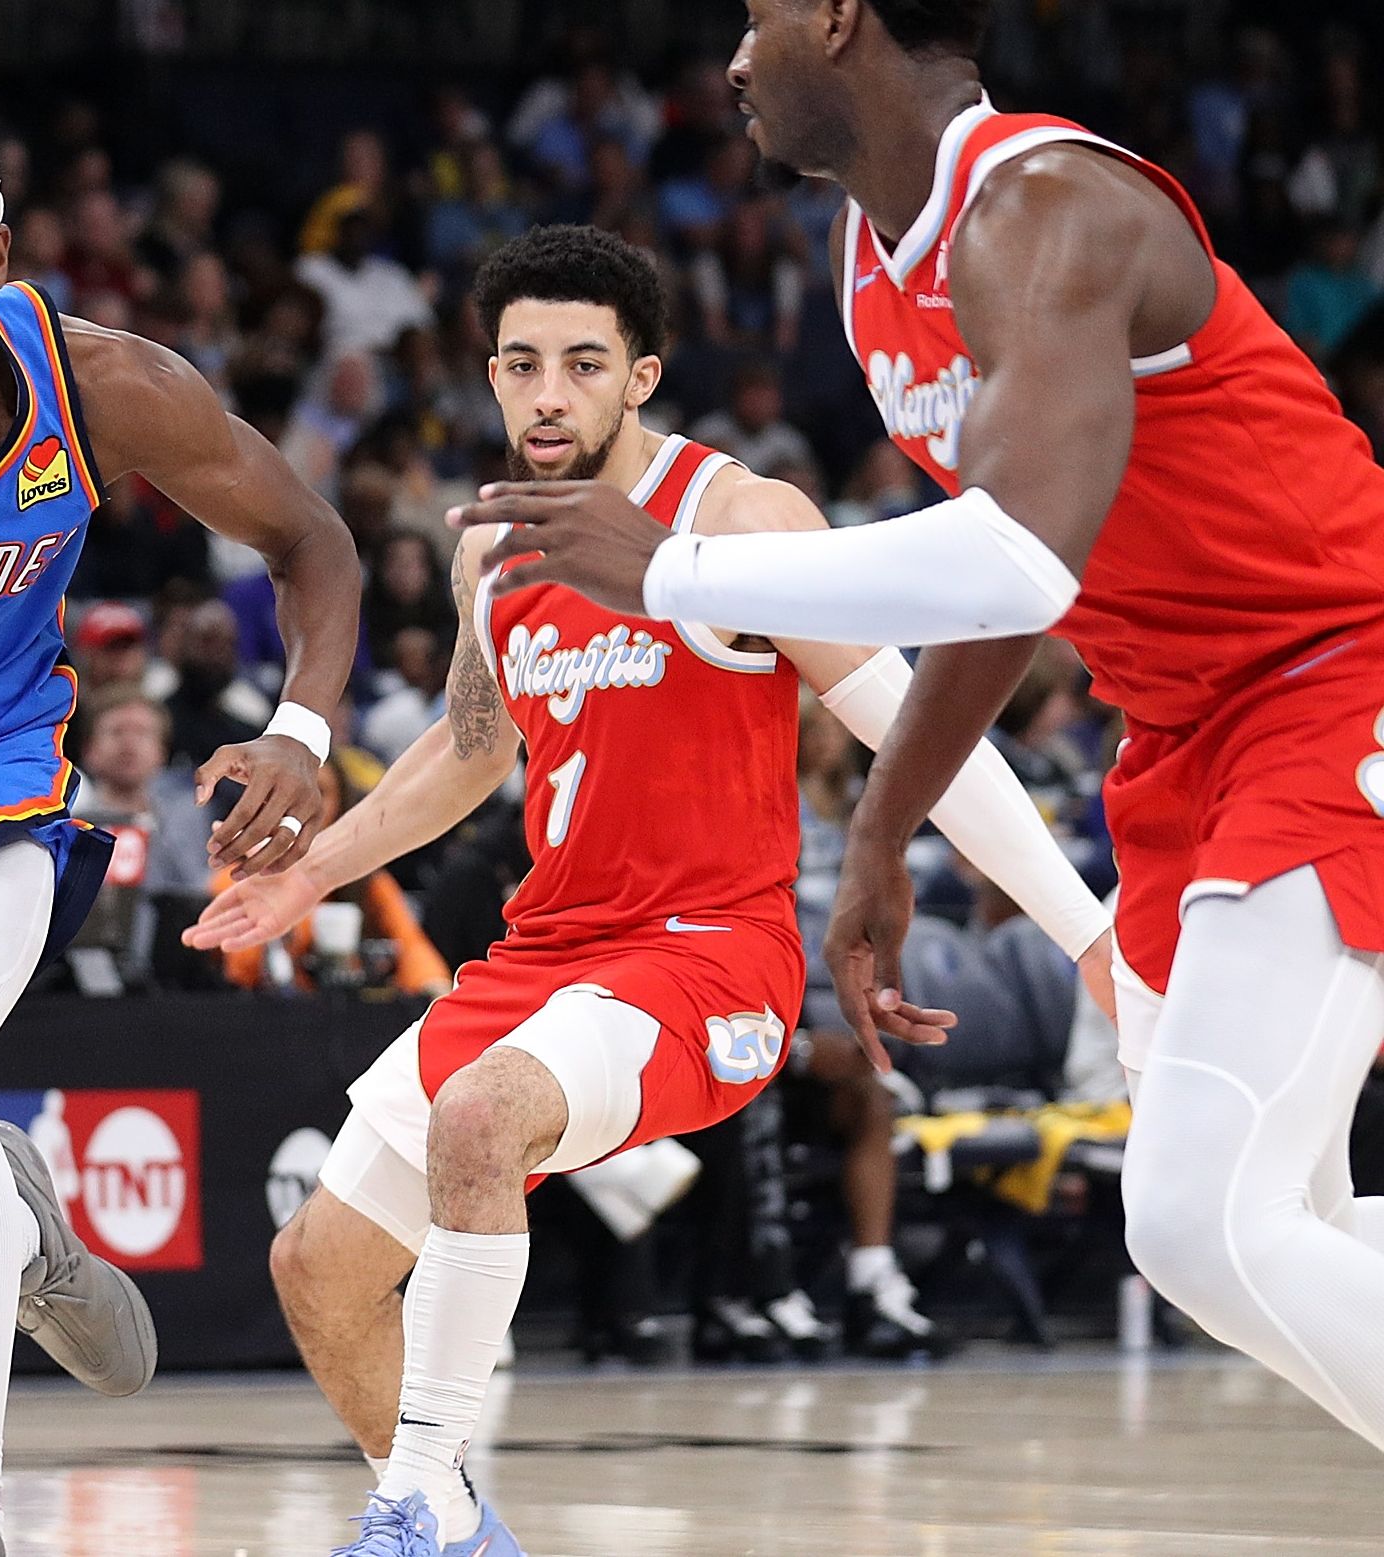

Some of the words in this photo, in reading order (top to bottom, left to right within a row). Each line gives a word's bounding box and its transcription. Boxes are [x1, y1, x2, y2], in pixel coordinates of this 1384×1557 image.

[916, 294, 953, 308] Robin
[867, 349, 981, 470] Memph
[501, 623, 673, 725] Memphis
[547, 749, 587, 848] 1
[83, 1159, 183, 1212] TNT
